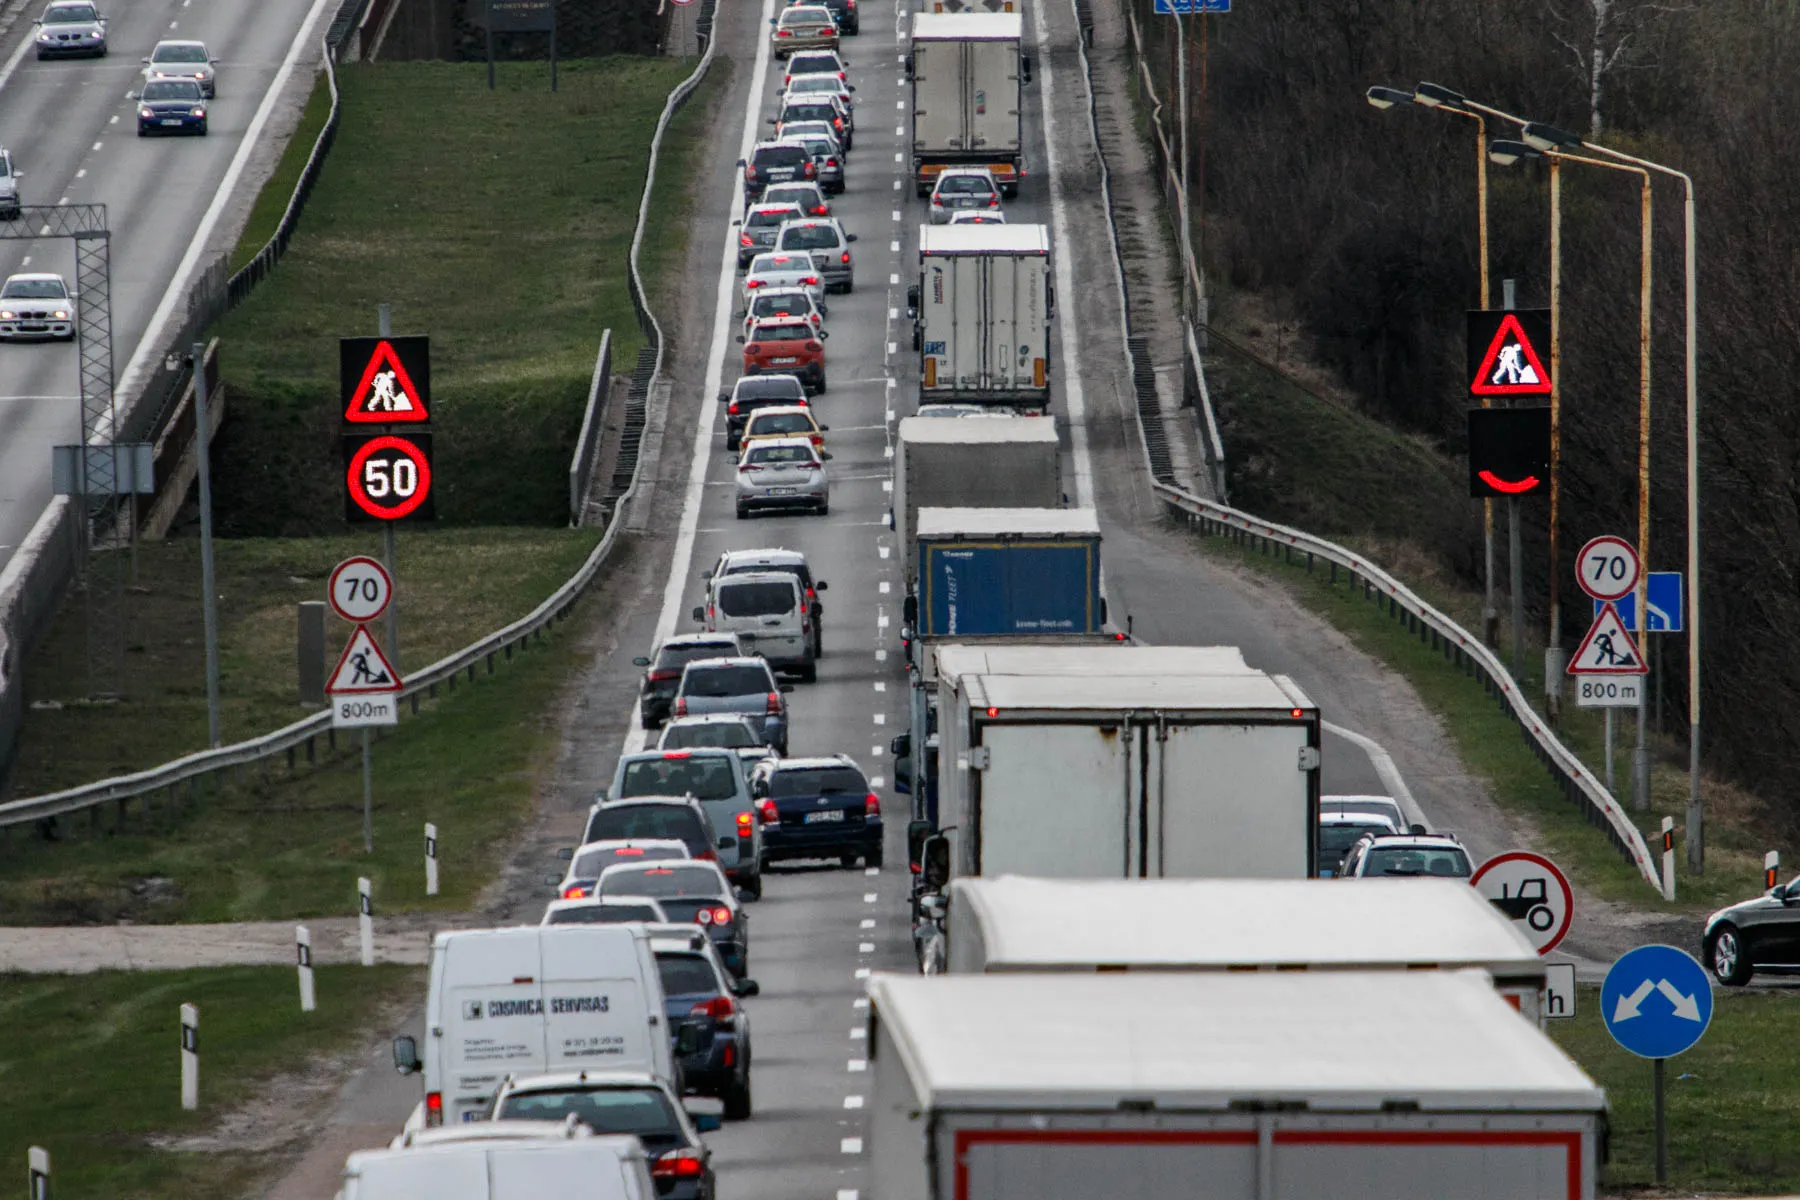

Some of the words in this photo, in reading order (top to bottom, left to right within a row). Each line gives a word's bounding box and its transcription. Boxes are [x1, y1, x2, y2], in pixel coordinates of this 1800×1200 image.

[365, 458, 418, 497] 50
[1591, 556, 1626, 581] 70
[344, 578, 378, 602] 70
[1582, 683, 1618, 698] 800
[1621, 686, 1636, 698] m
[341, 702, 389, 719] 800m
[488, 999, 545, 1018] COSMICA
[551, 996, 609, 1014] SERVISAS
